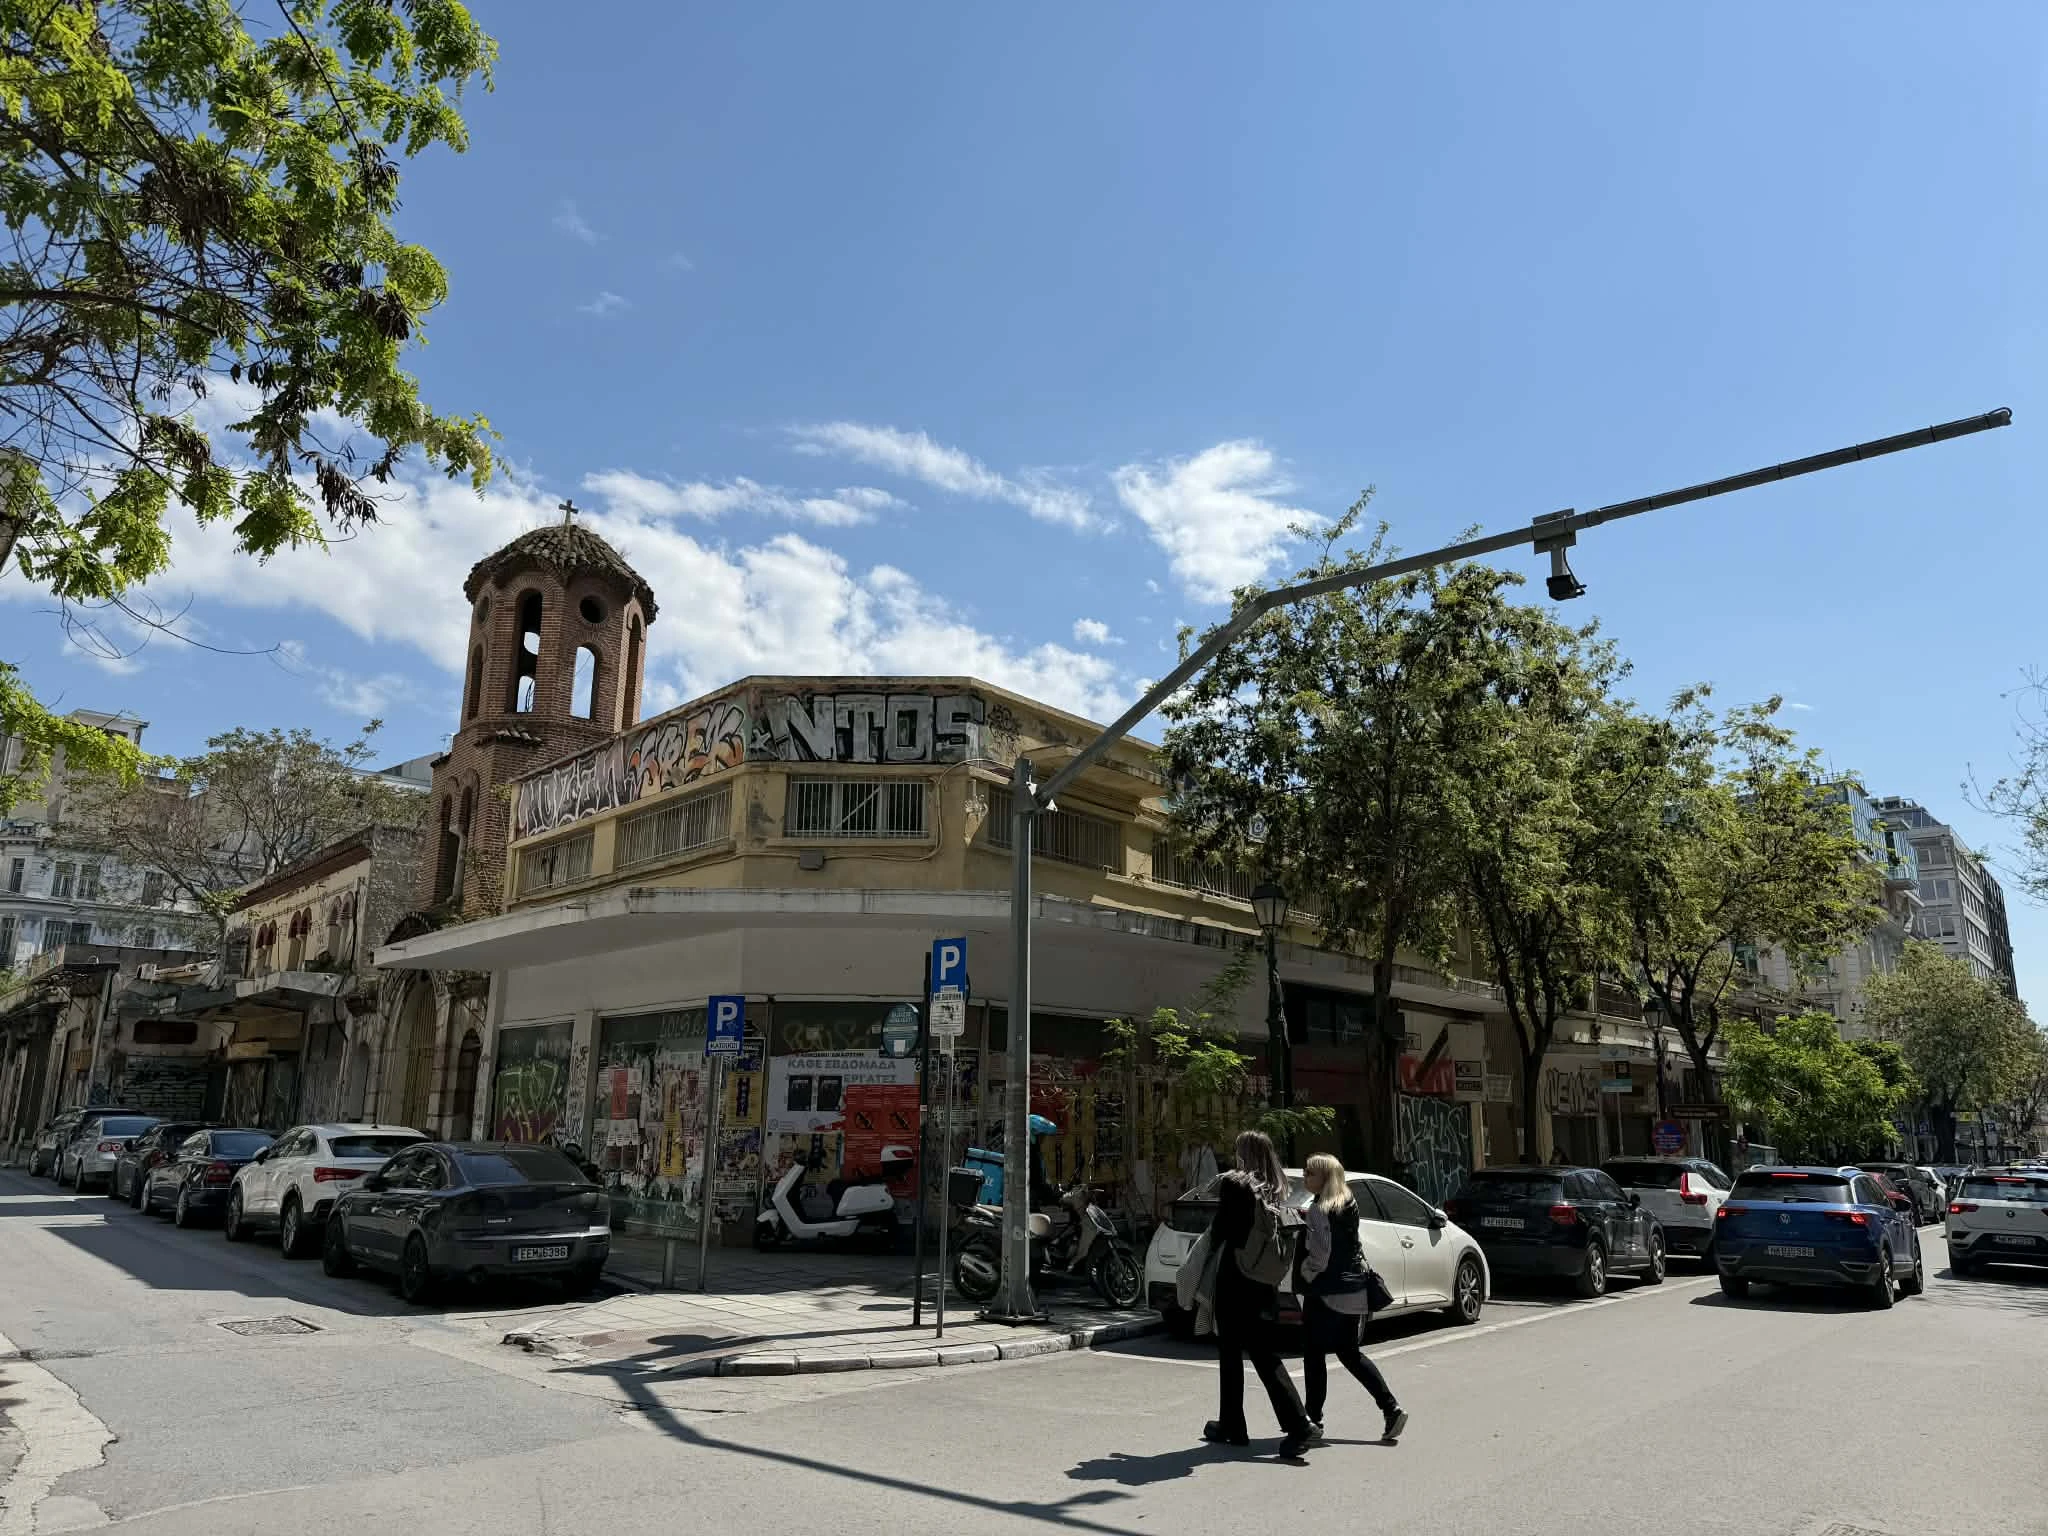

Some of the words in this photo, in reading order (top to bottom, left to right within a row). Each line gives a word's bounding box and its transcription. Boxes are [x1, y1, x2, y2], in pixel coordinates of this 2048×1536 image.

[940, 945, 961, 981] P
[716, 1001, 738, 1032] P
[787, 1059, 823, 1069] ΚΑΘΕ
